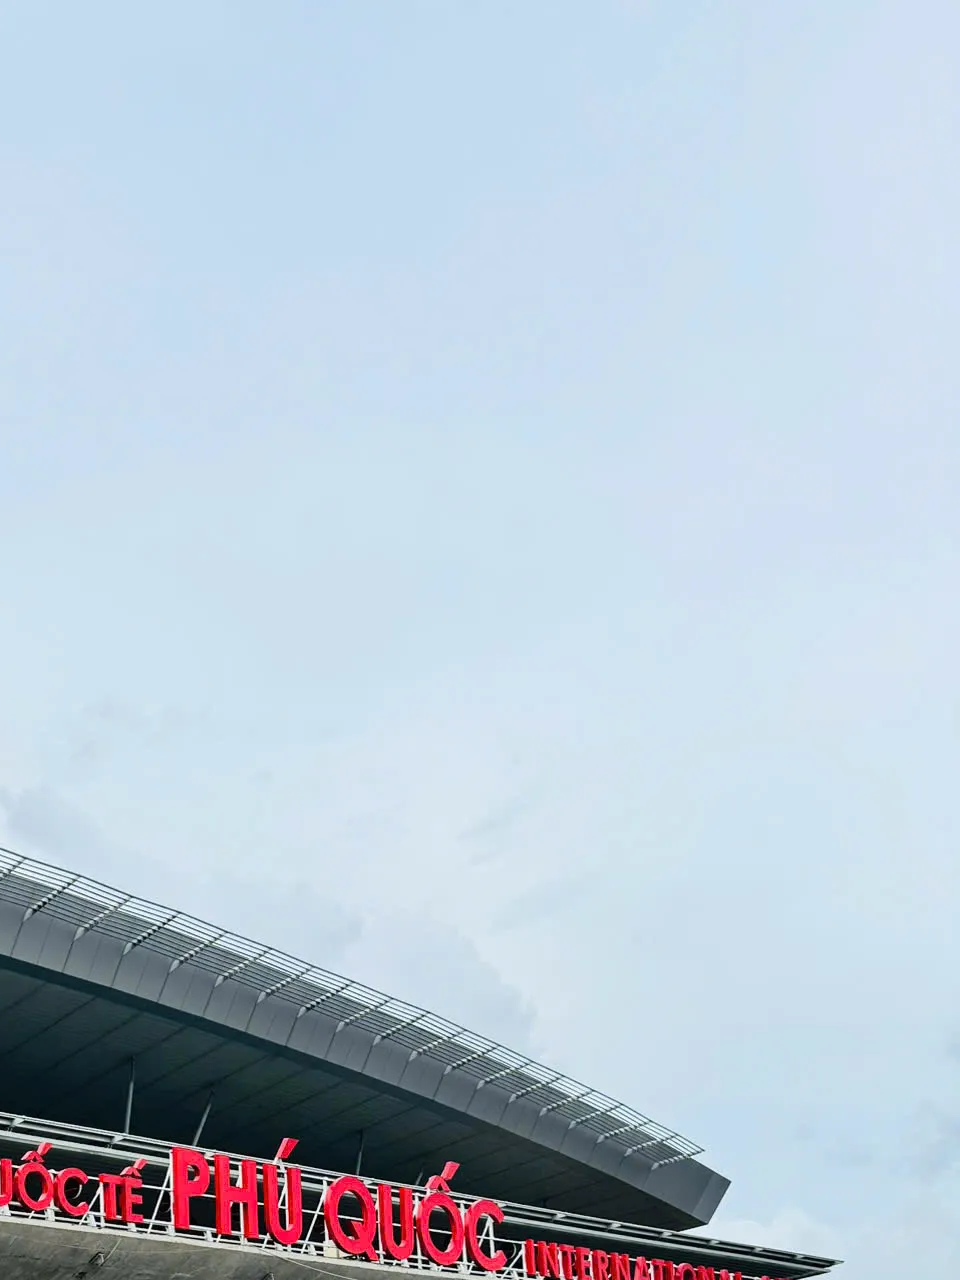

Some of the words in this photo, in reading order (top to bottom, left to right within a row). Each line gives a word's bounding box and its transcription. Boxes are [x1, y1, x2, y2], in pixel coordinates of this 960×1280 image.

[97, 1159, 147, 1224] TẾ
[171, 1138, 303, 1246] PHÚ
[324, 1161, 508, 1273] QUỐC
